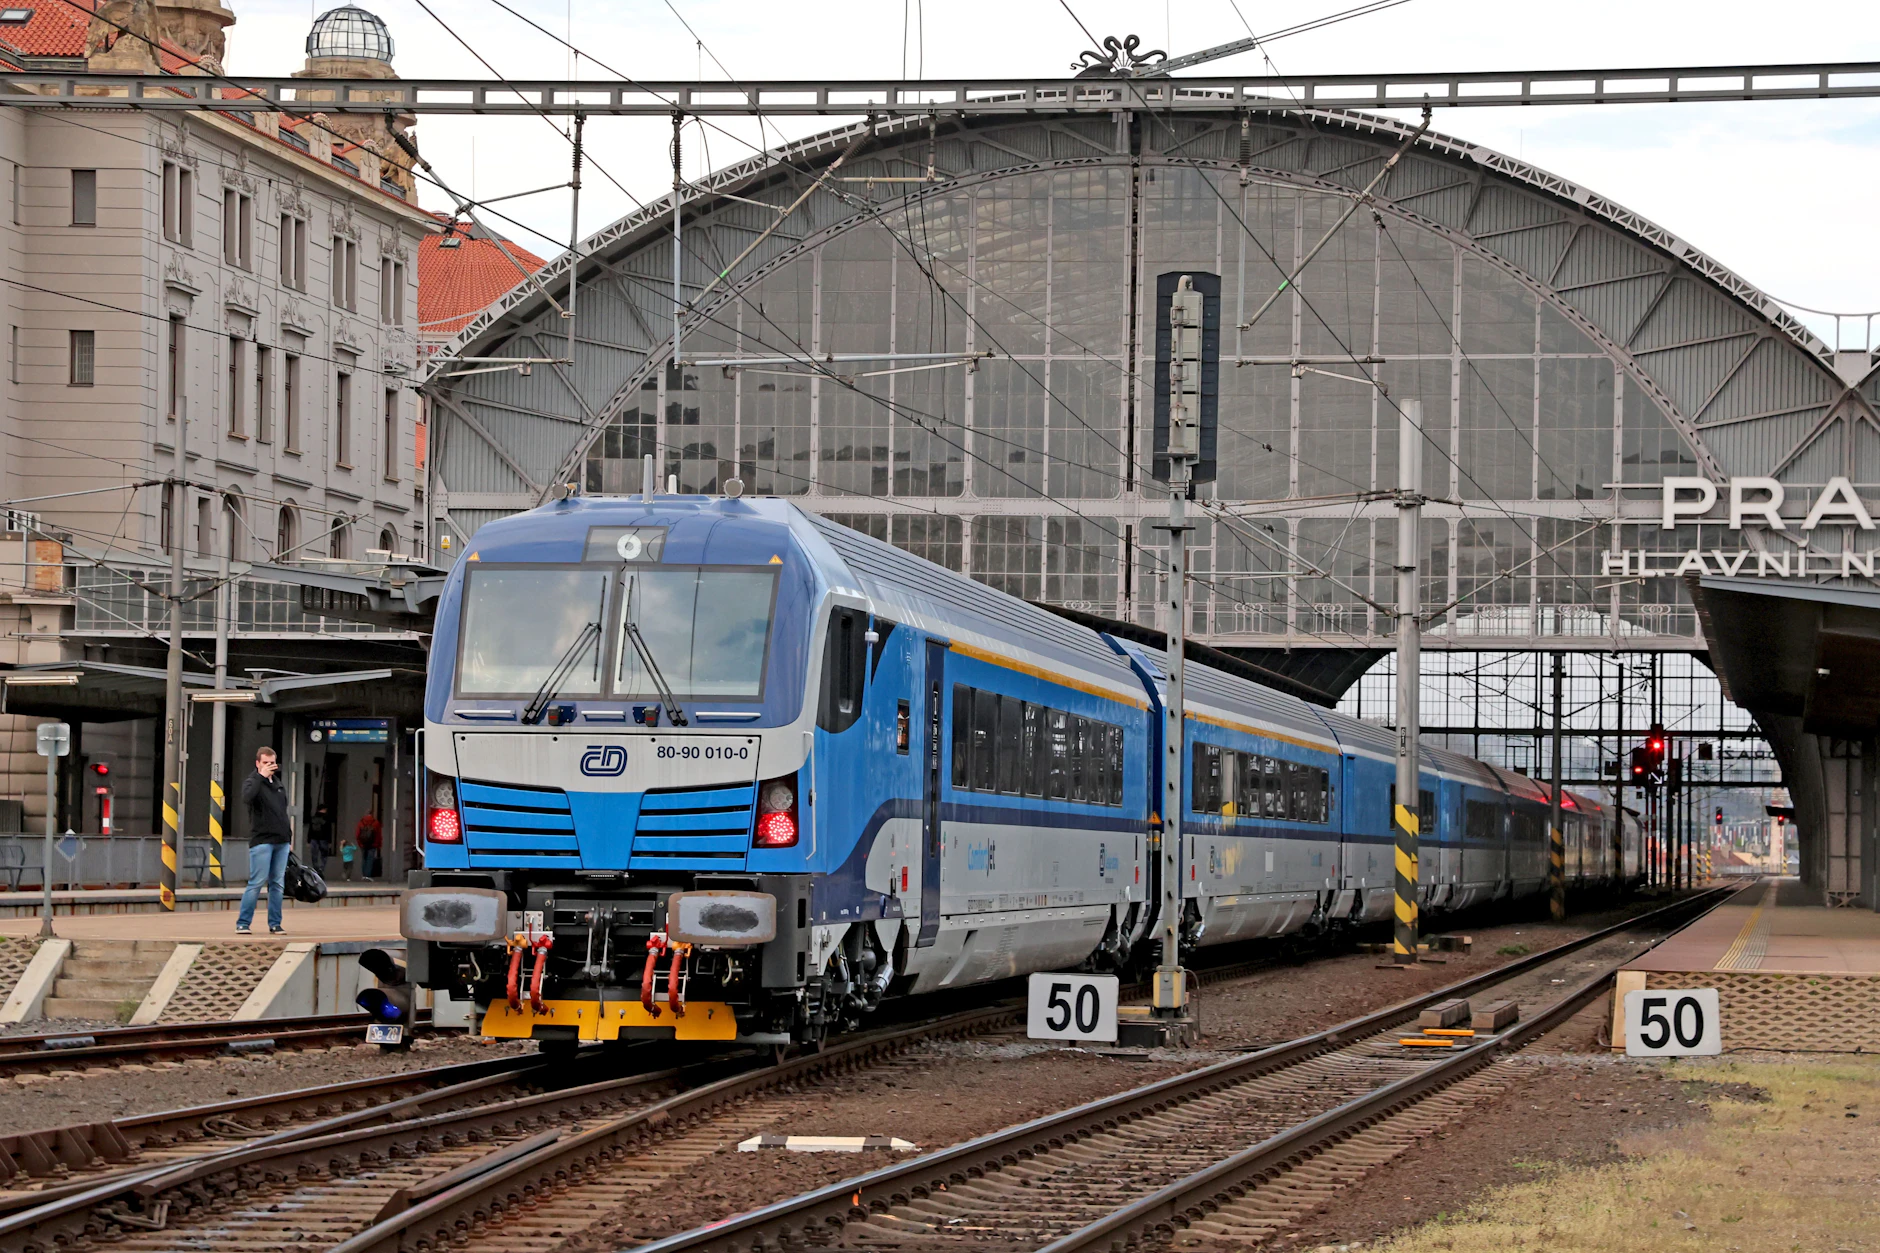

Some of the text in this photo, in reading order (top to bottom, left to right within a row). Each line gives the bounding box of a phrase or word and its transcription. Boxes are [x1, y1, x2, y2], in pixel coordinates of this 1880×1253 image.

[1662, 476, 1876, 530] PRA
[657, 745, 748, 760] 80-90 010-0
[371, 1026, 383, 1041] Se
[1045, 982, 1100, 1034] 50
[1640, 996, 1704, 1049] 50
